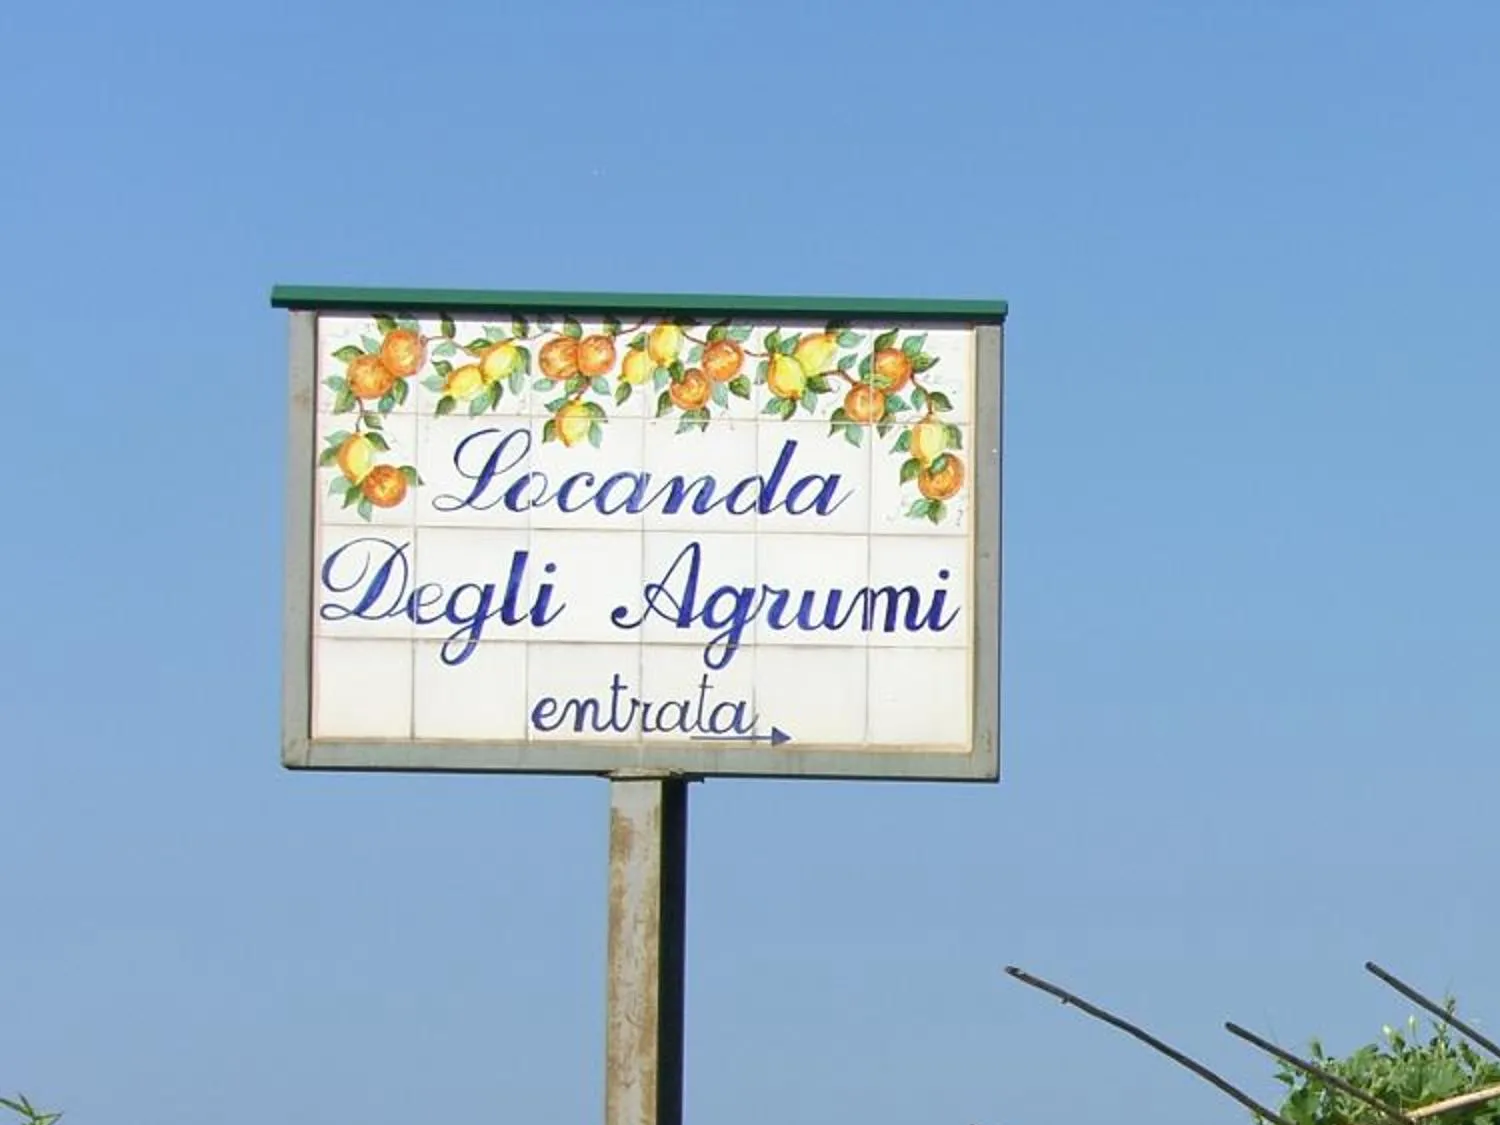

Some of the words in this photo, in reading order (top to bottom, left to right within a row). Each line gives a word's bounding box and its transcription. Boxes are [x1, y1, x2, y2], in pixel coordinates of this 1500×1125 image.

[432, 427, 854, 516] Locanda
[320, 537, 566, 666] Degli
[611, 541, 960, 671] Agrumi
[531, 674, 758, 736] entrata
